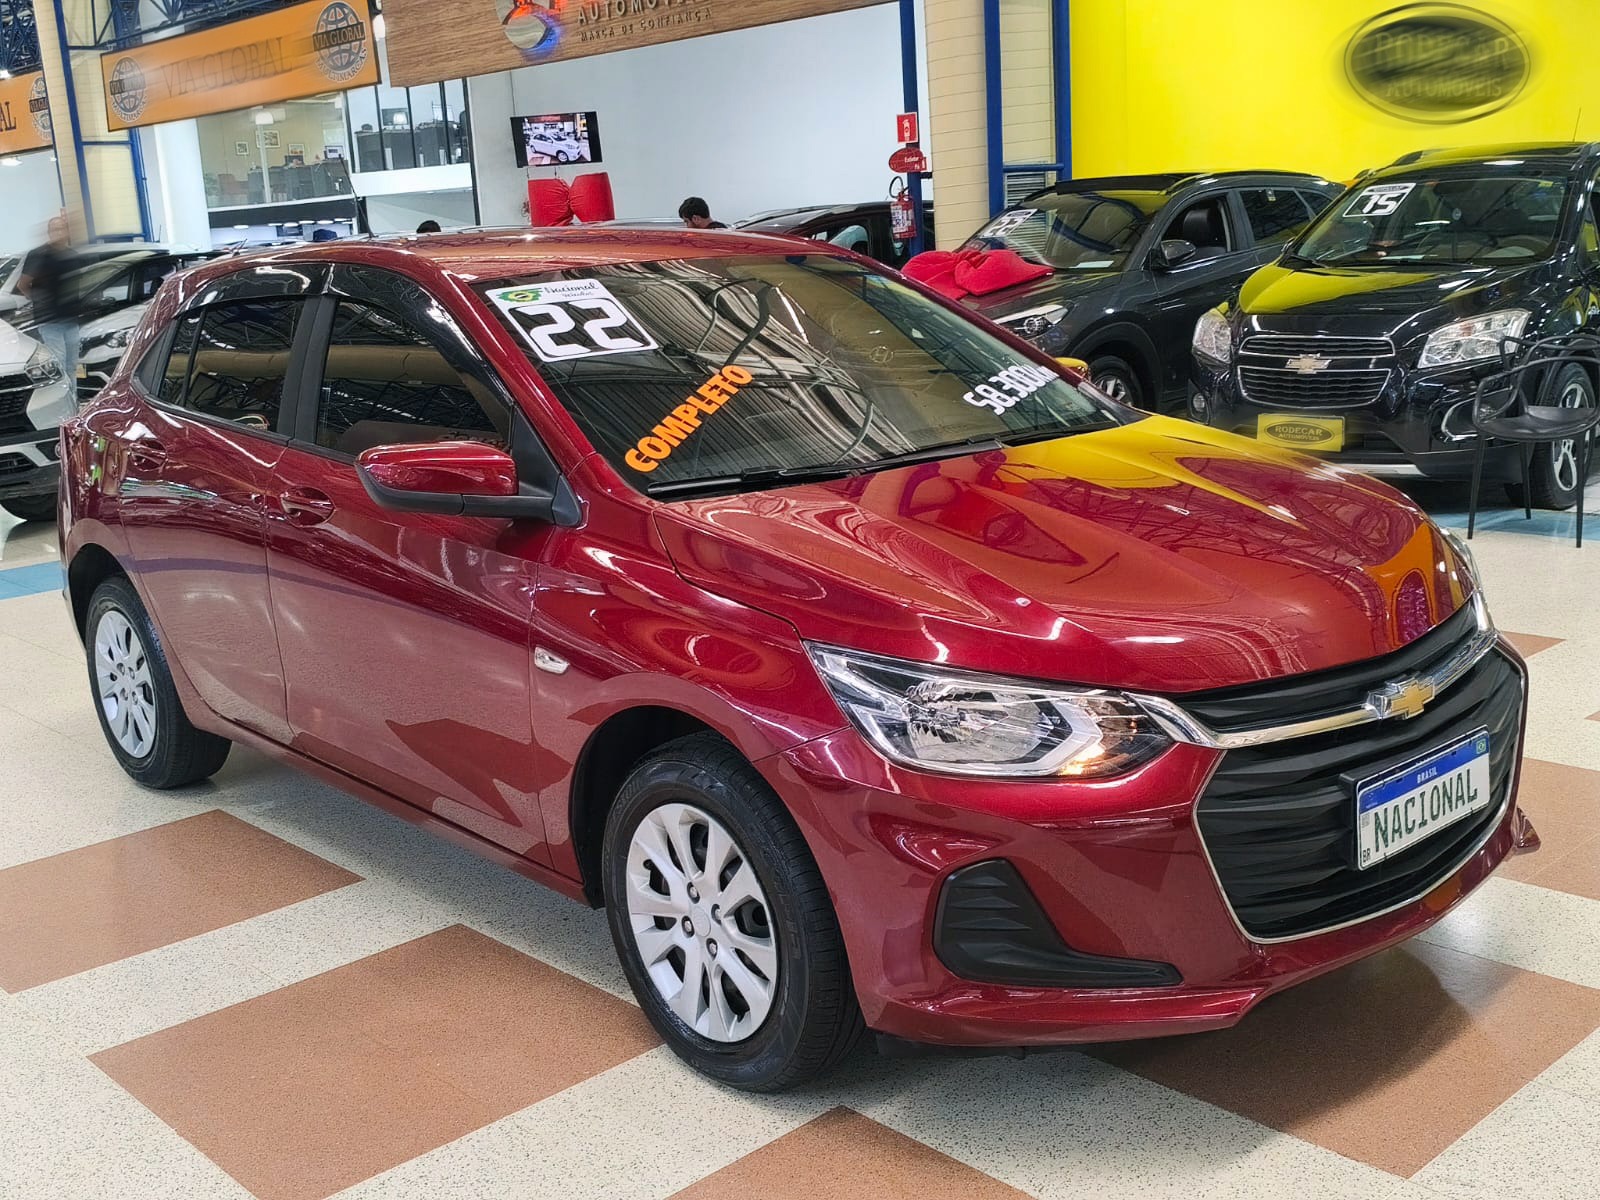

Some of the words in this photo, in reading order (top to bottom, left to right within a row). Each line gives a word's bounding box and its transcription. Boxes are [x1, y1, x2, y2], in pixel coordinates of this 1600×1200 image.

[330, 25, 365, 45] GLOBAL
[202, 36, 293, 90] GLOBAL
[1362, 193, 1402, 214] 15
[515, 298, 645, 357] 22
[624, 365, 753, 472] COMPLETO
[1275, 425, 1323, 437] RODECAR
[1416, 767, 1438, 784] BRASIL
[1374, 768, 1478, 853] NACIONAL
[1362, 847, 1371, 863] BR
